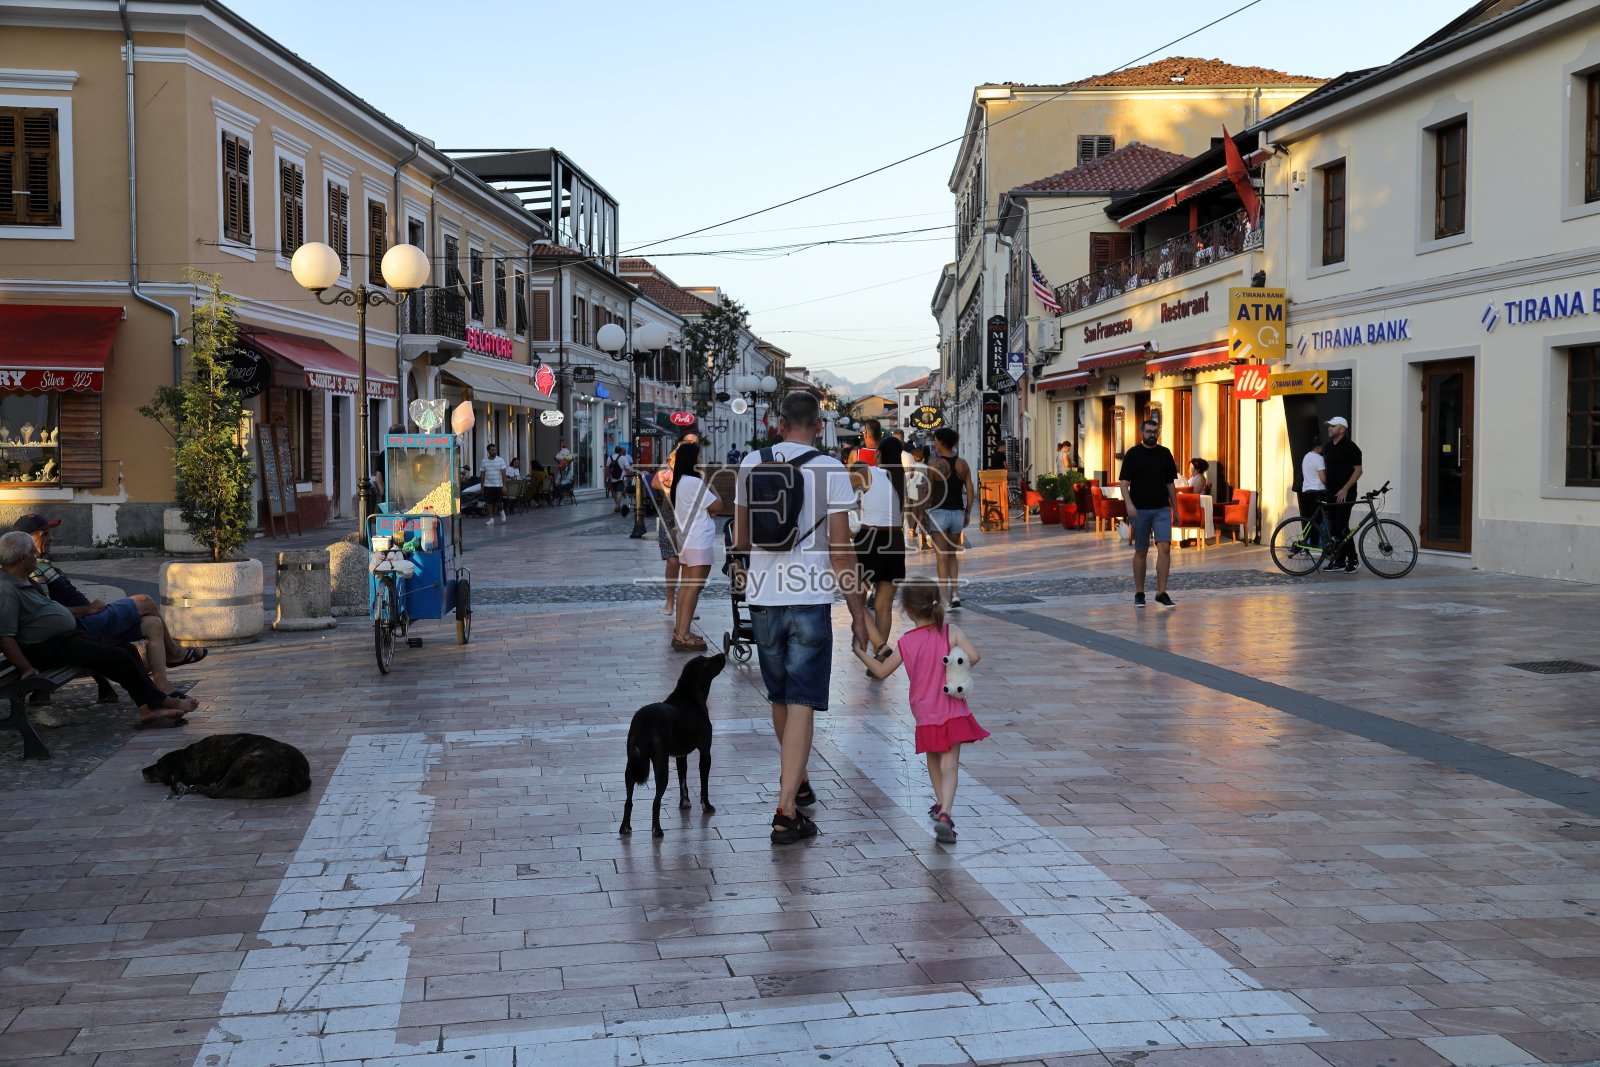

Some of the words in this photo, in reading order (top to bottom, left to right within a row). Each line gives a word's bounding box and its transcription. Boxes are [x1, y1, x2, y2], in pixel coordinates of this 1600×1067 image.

[1161, 291, 1209, 323] Restorant
[1237, 303, 1283, 321] ATM
[1504, 291, 1585, 324] TIRANA
[465, 327, 513, 360] GELATERIA
[1084, 326, 1096, 343] San
[1097, 318, 1133, 340] Francisco
[1312, 325, 1362, 350] TIRANA
[1367, 318, 1408, 343] BANK
[992, 331, 1004, 375] MARKET
[40, 370, 65, 388] Silver
[72, 371, 93, 388] 925
[1236, 369, 1267, 396] illy
[1276, 380, 1292, 388] TIRANA
[1292, 379, 1303, 387] BANK
[985, 413, 998, 470] MARK
